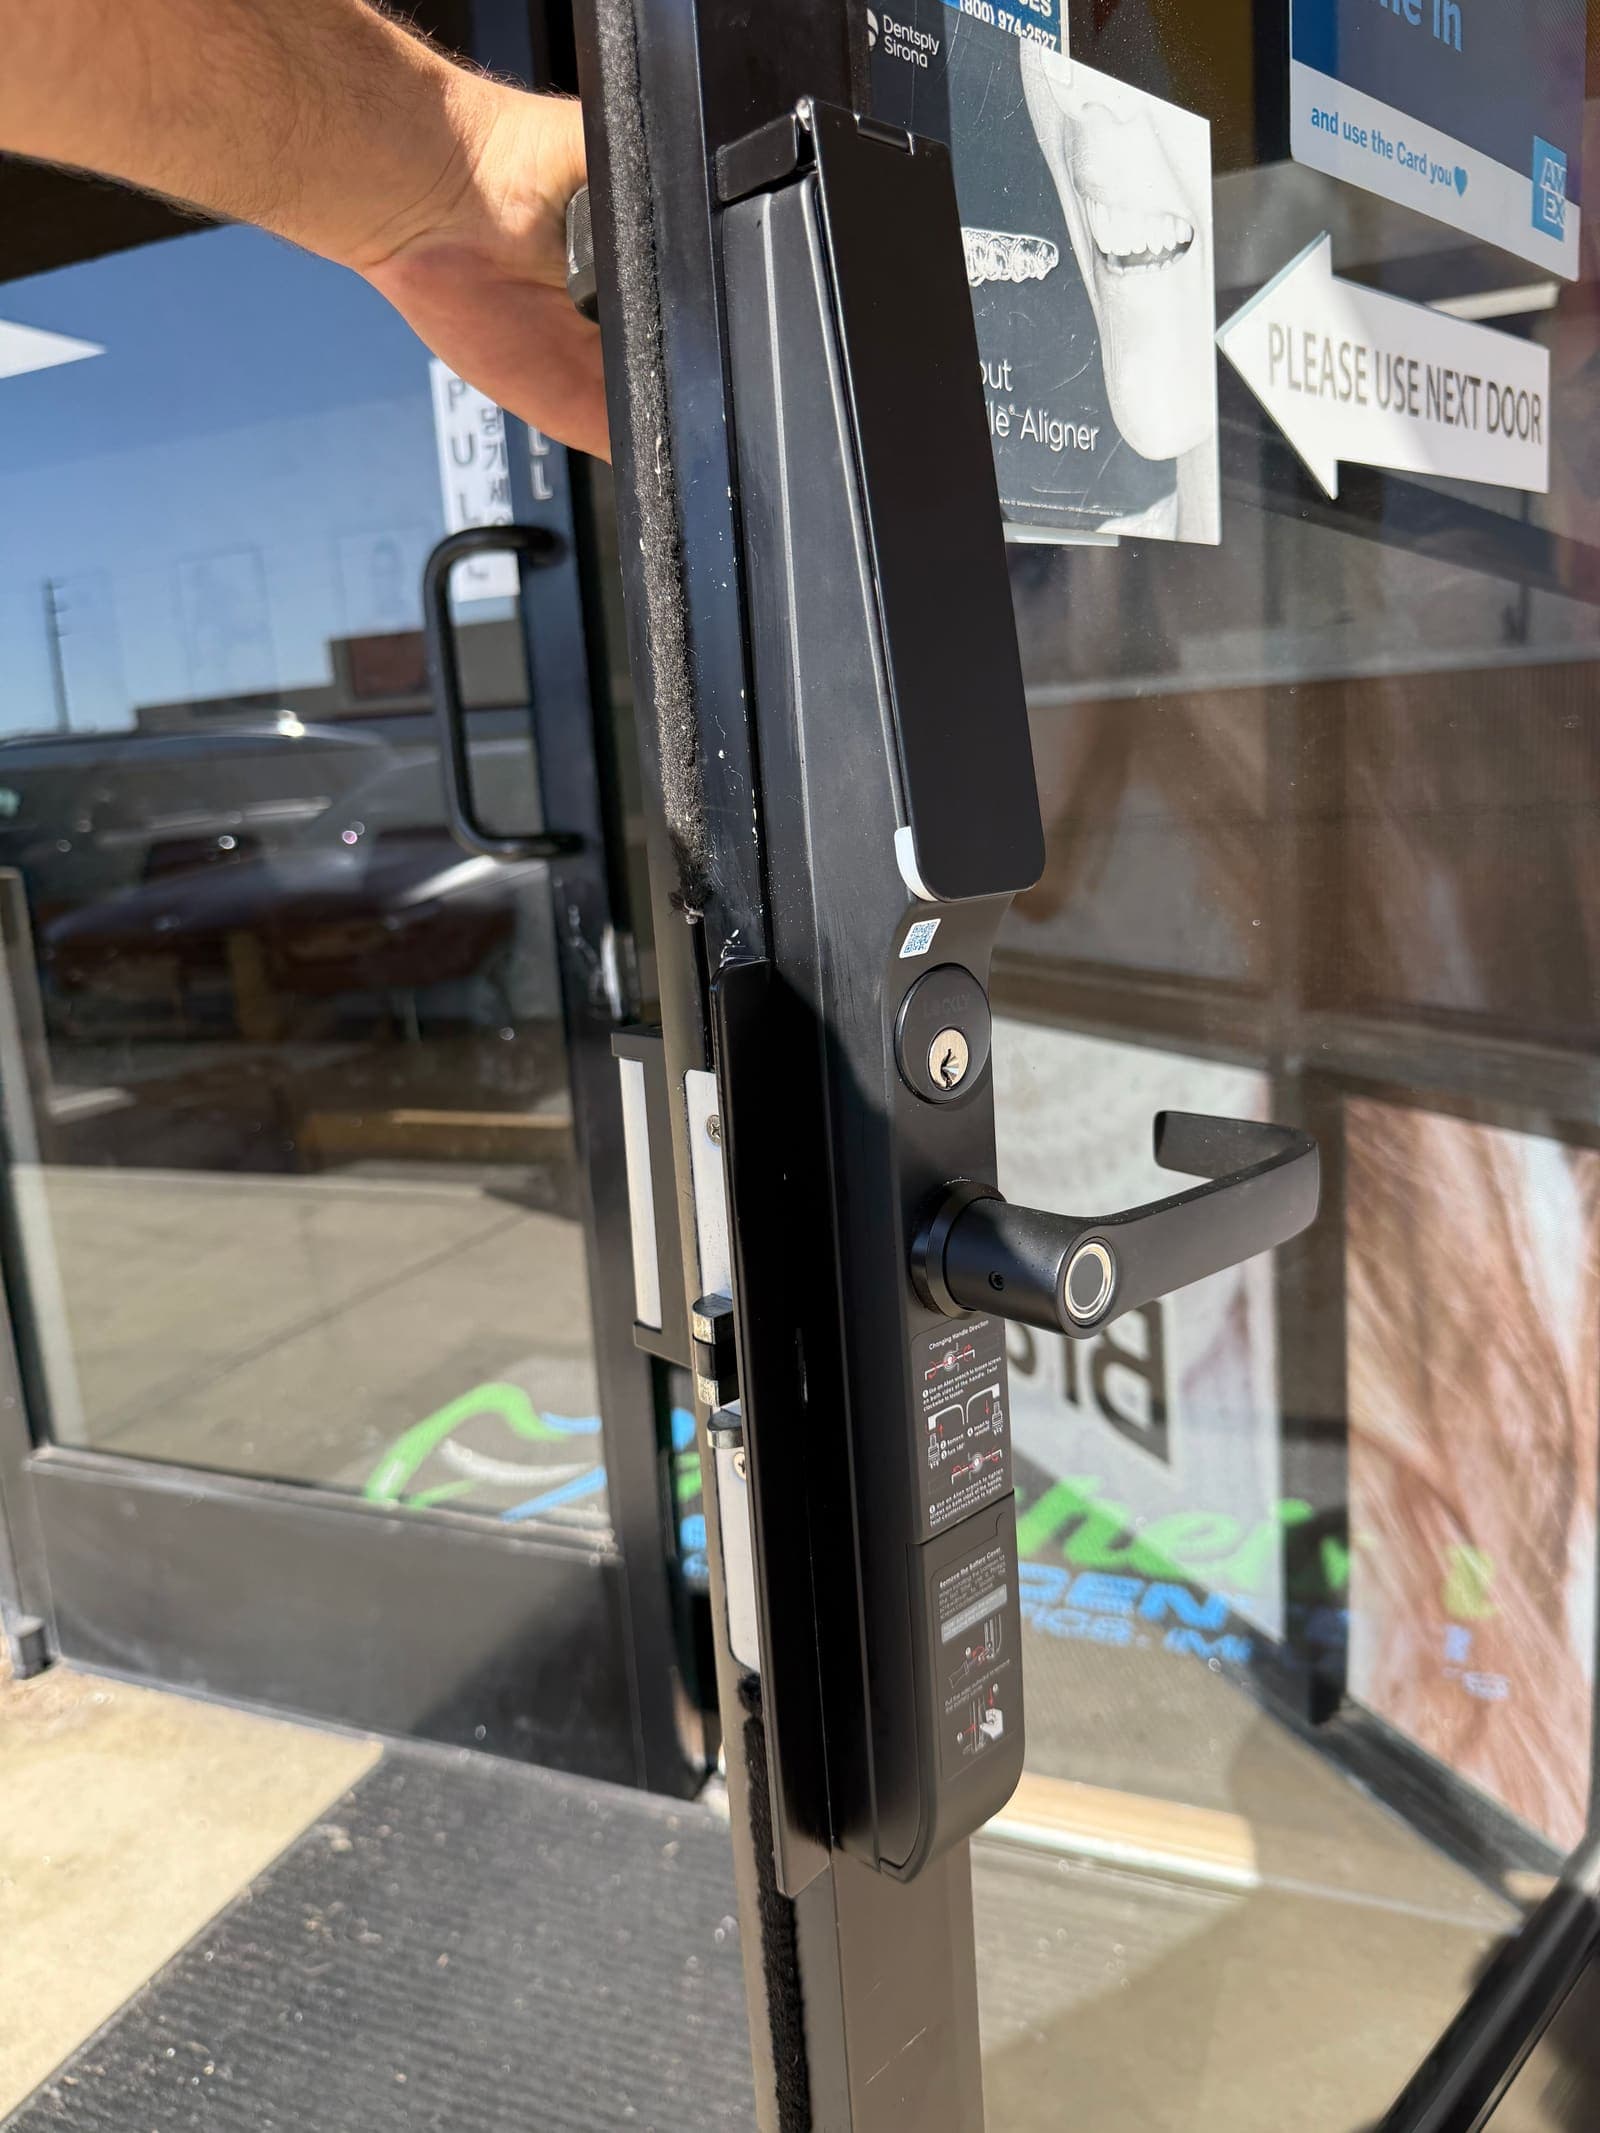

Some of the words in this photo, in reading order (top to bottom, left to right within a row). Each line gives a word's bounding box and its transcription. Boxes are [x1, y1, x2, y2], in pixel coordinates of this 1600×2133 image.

[883, 15, 940, 55] Dentsply
[998, 10, 1056, 51] 974-2527
[1380, 0, 1422, 26] e
[1433, 0, 1462, 52] in
[884, 37, 928, 68] Sirona
[1311, 107, 1338, 135] and
[1343, 121, 1367, 148] use
[1371, 129, 1393, 160] the
[1397, 142, 1427, 175] Card
[1430, 161, 1451, 186] you
[1268, 322, 1367, 405] PLEASE
[1375, 350, 1419, 417] USE
[1426, 363, 1481, 430] NEXT
[1486, 381, 1542, 444] DOOR
[1020, 408, 1100, 452] Aligner
[929, 1336, 951, 1350] Changing
[952, 1328, 968, 1340] Handle
[969, 1320, 988, 1332] Direction
[987, 1546, 1000, 1559] Cover
